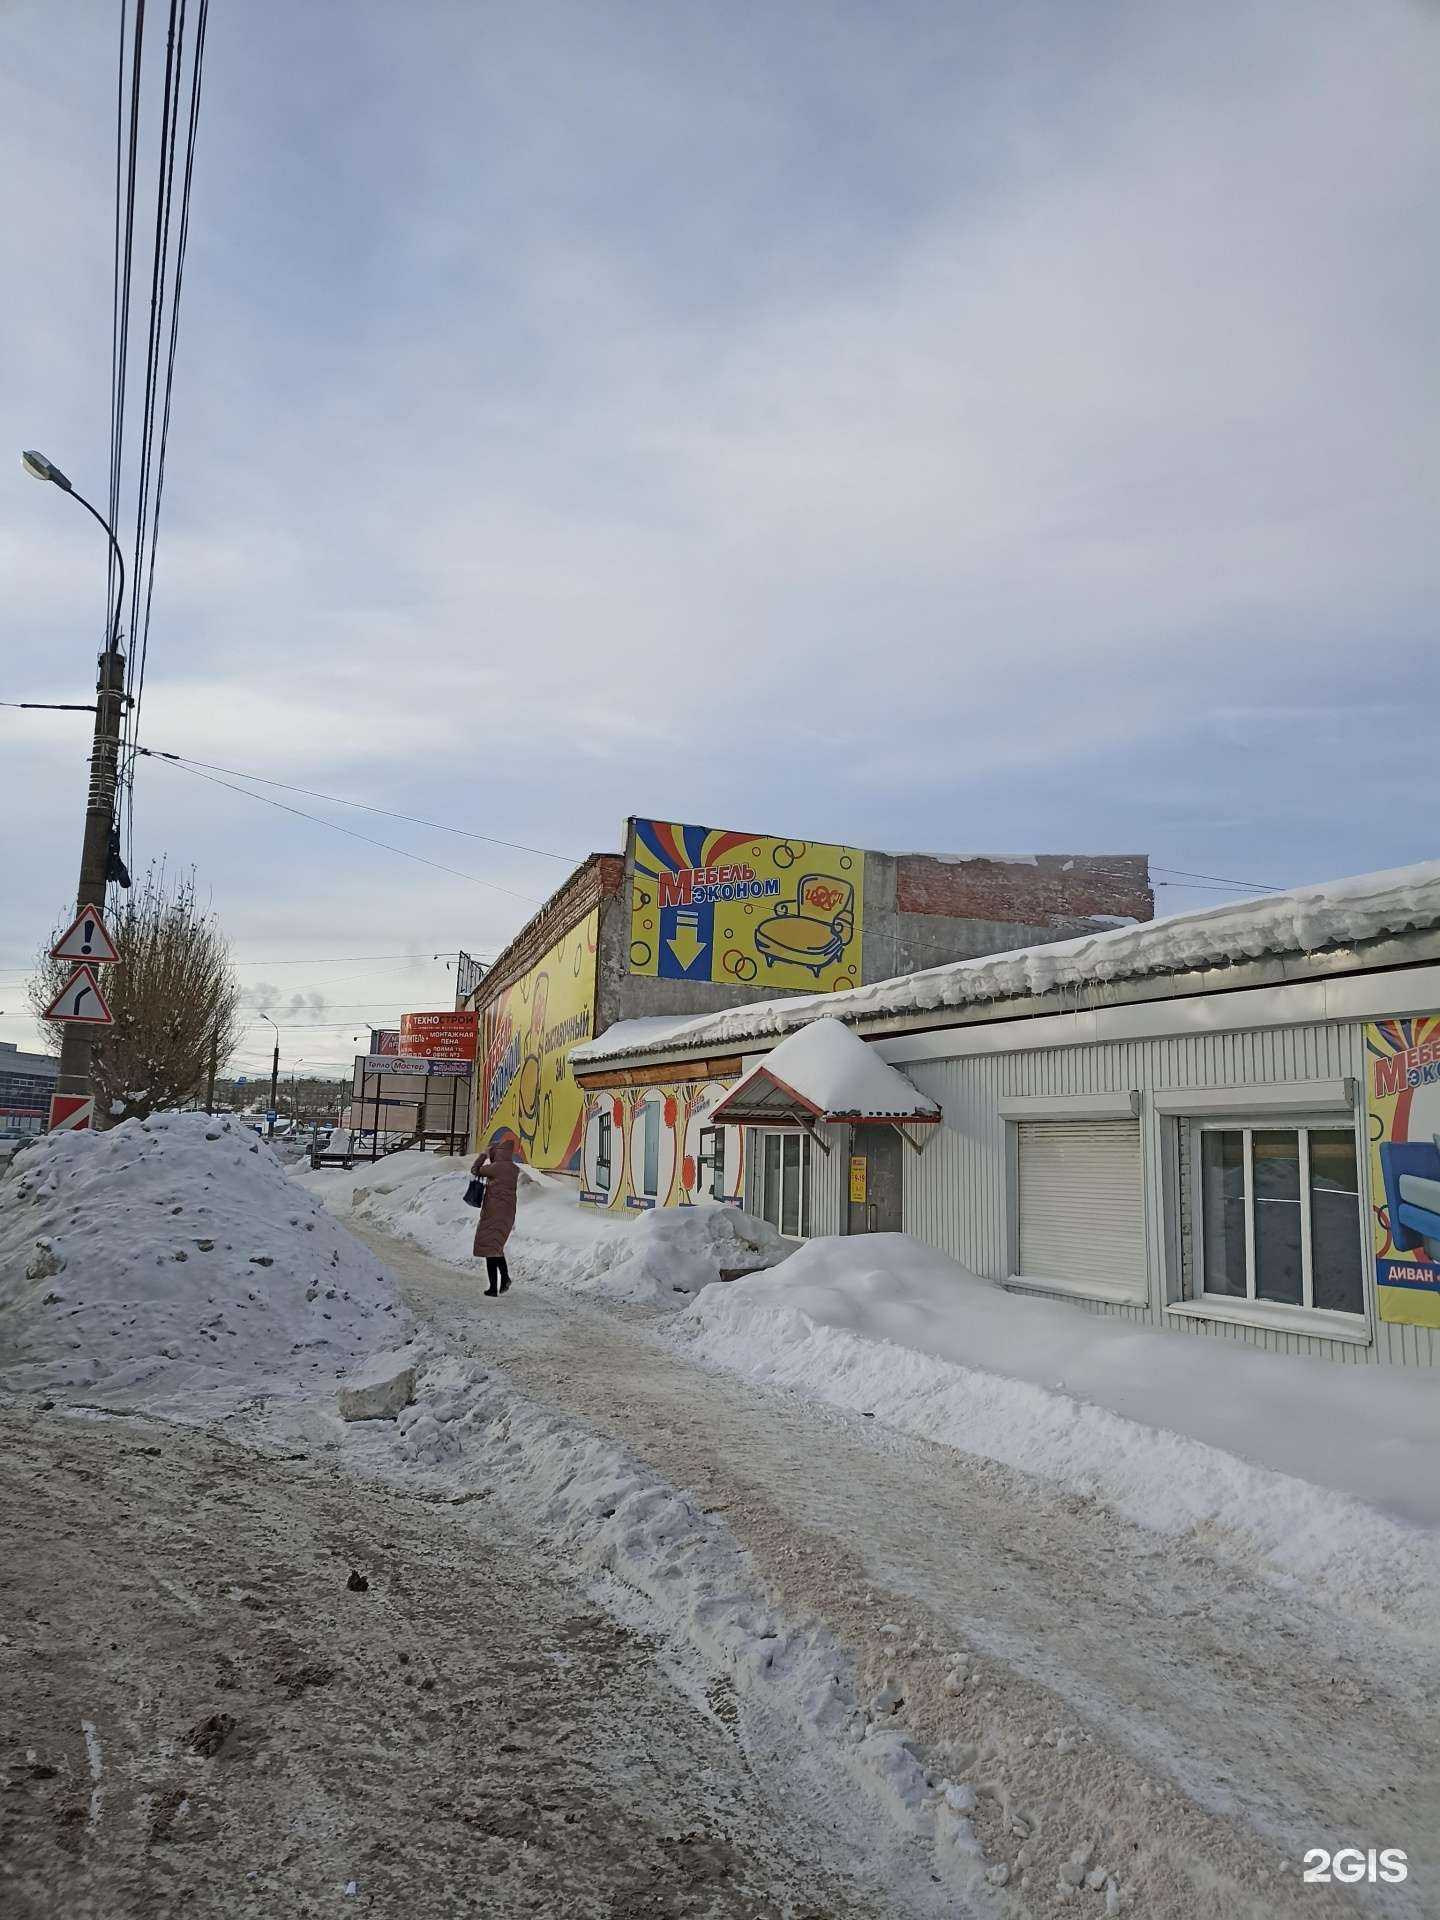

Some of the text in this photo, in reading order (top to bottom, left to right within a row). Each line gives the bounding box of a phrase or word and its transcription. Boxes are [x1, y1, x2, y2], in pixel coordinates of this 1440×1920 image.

[657, 864, 756, 908] МЕБЕЛЬ
[693, 879, 780, 904] ЭКОНОМ
[1388, 1266, 1434, 1282] ДИВАН
